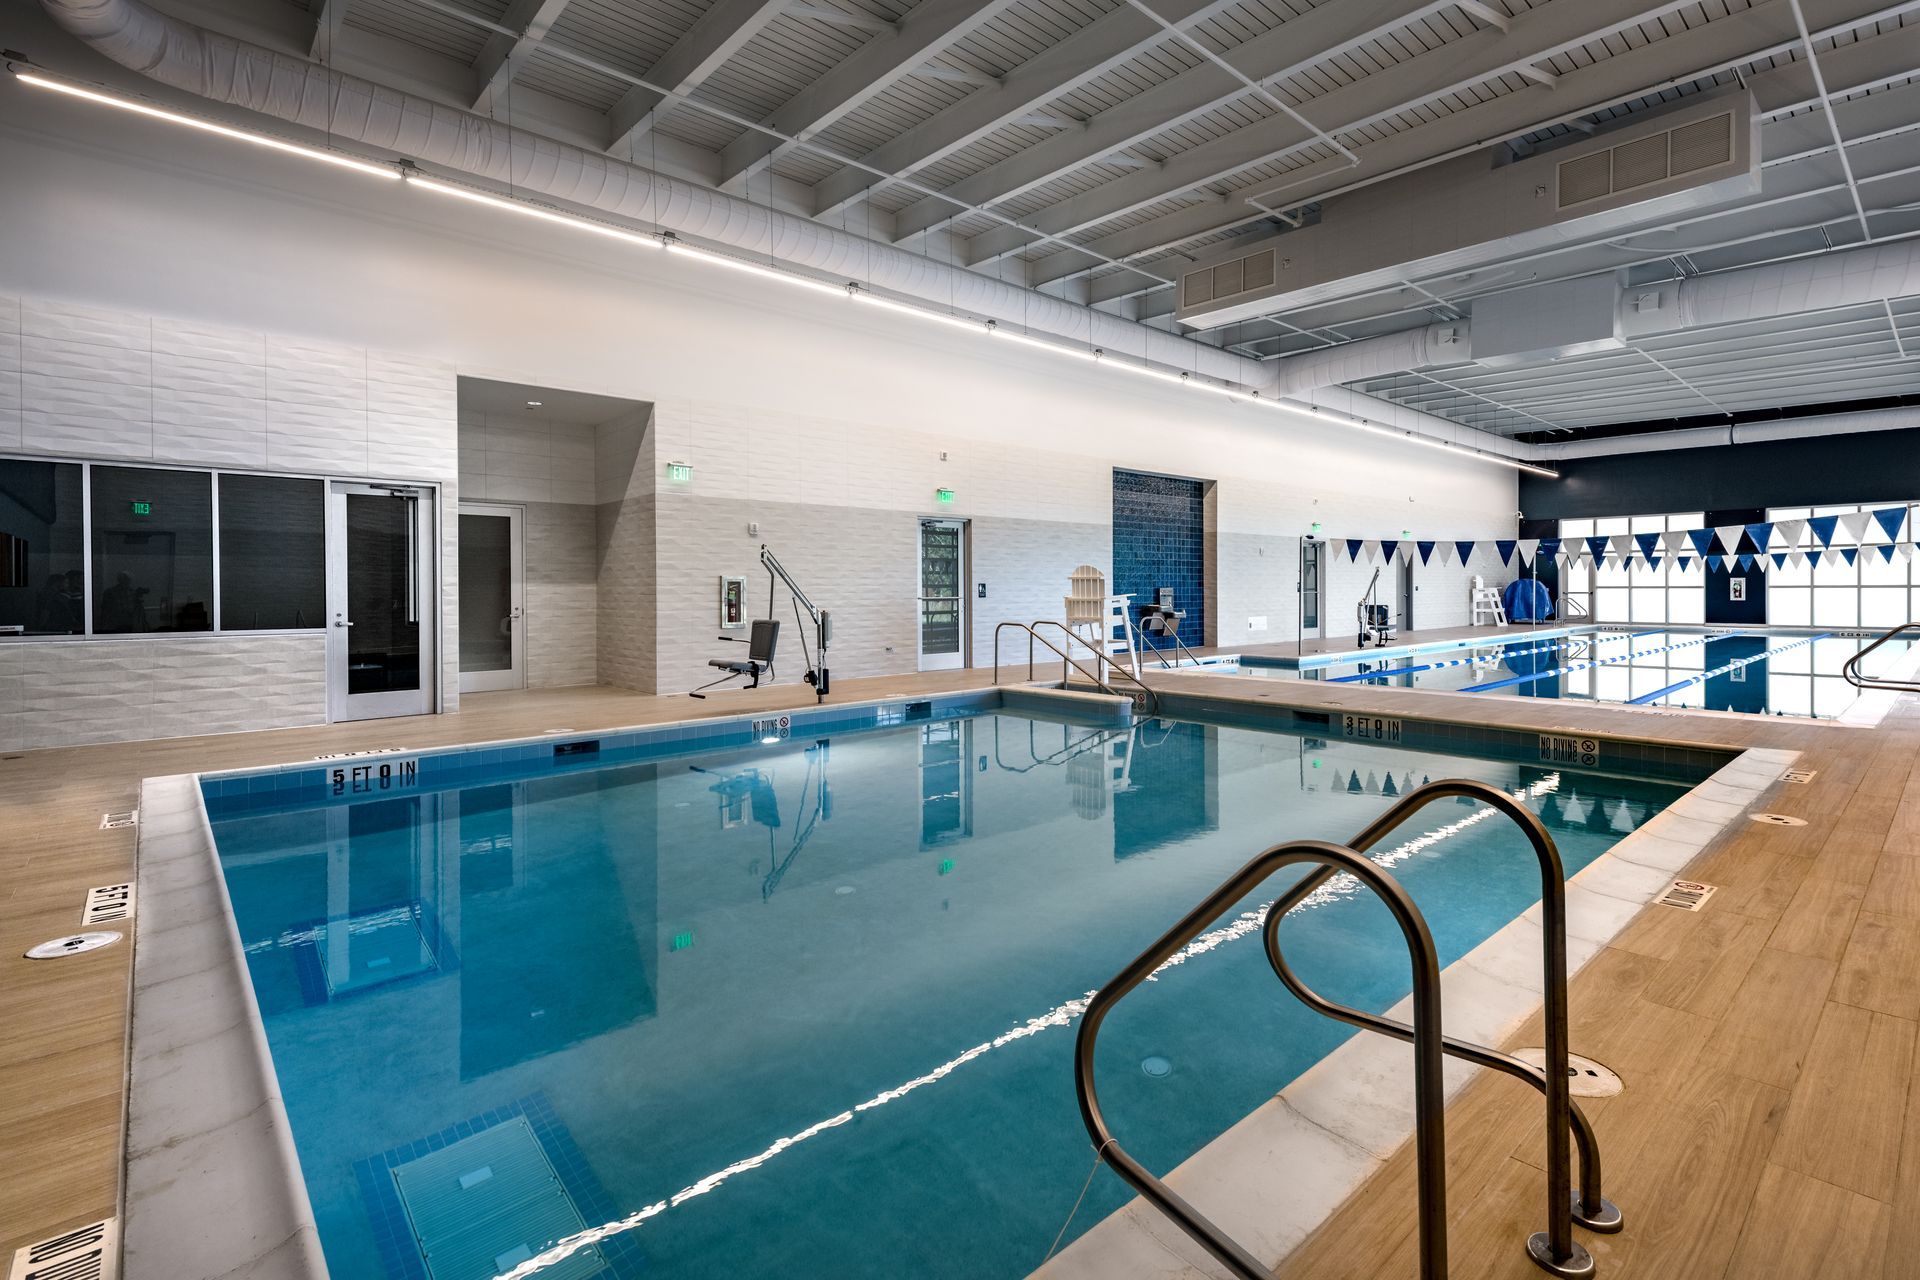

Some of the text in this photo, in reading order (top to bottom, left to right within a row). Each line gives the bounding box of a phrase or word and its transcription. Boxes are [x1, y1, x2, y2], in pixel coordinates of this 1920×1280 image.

[673, 466, 691, 481] EXIT
[752, 720, 760, 733] NO
[1346, 716, 1354, 727] 3
[1358, 717, 1371, 729] FT
[1387, 720, 1400, 733] IN
[1541, 736, 1578, 753] NO DIVING
[333, 769, 345, 784] 5
[352, 765, 372, 782] FT
[400, 760, 416, 776] IN
[95, 884, 129, 894] 5
[94, 891, 128, 904] FT
[89, 909, 127, 924] IN
[28, 1222, 105, 1264] NO
